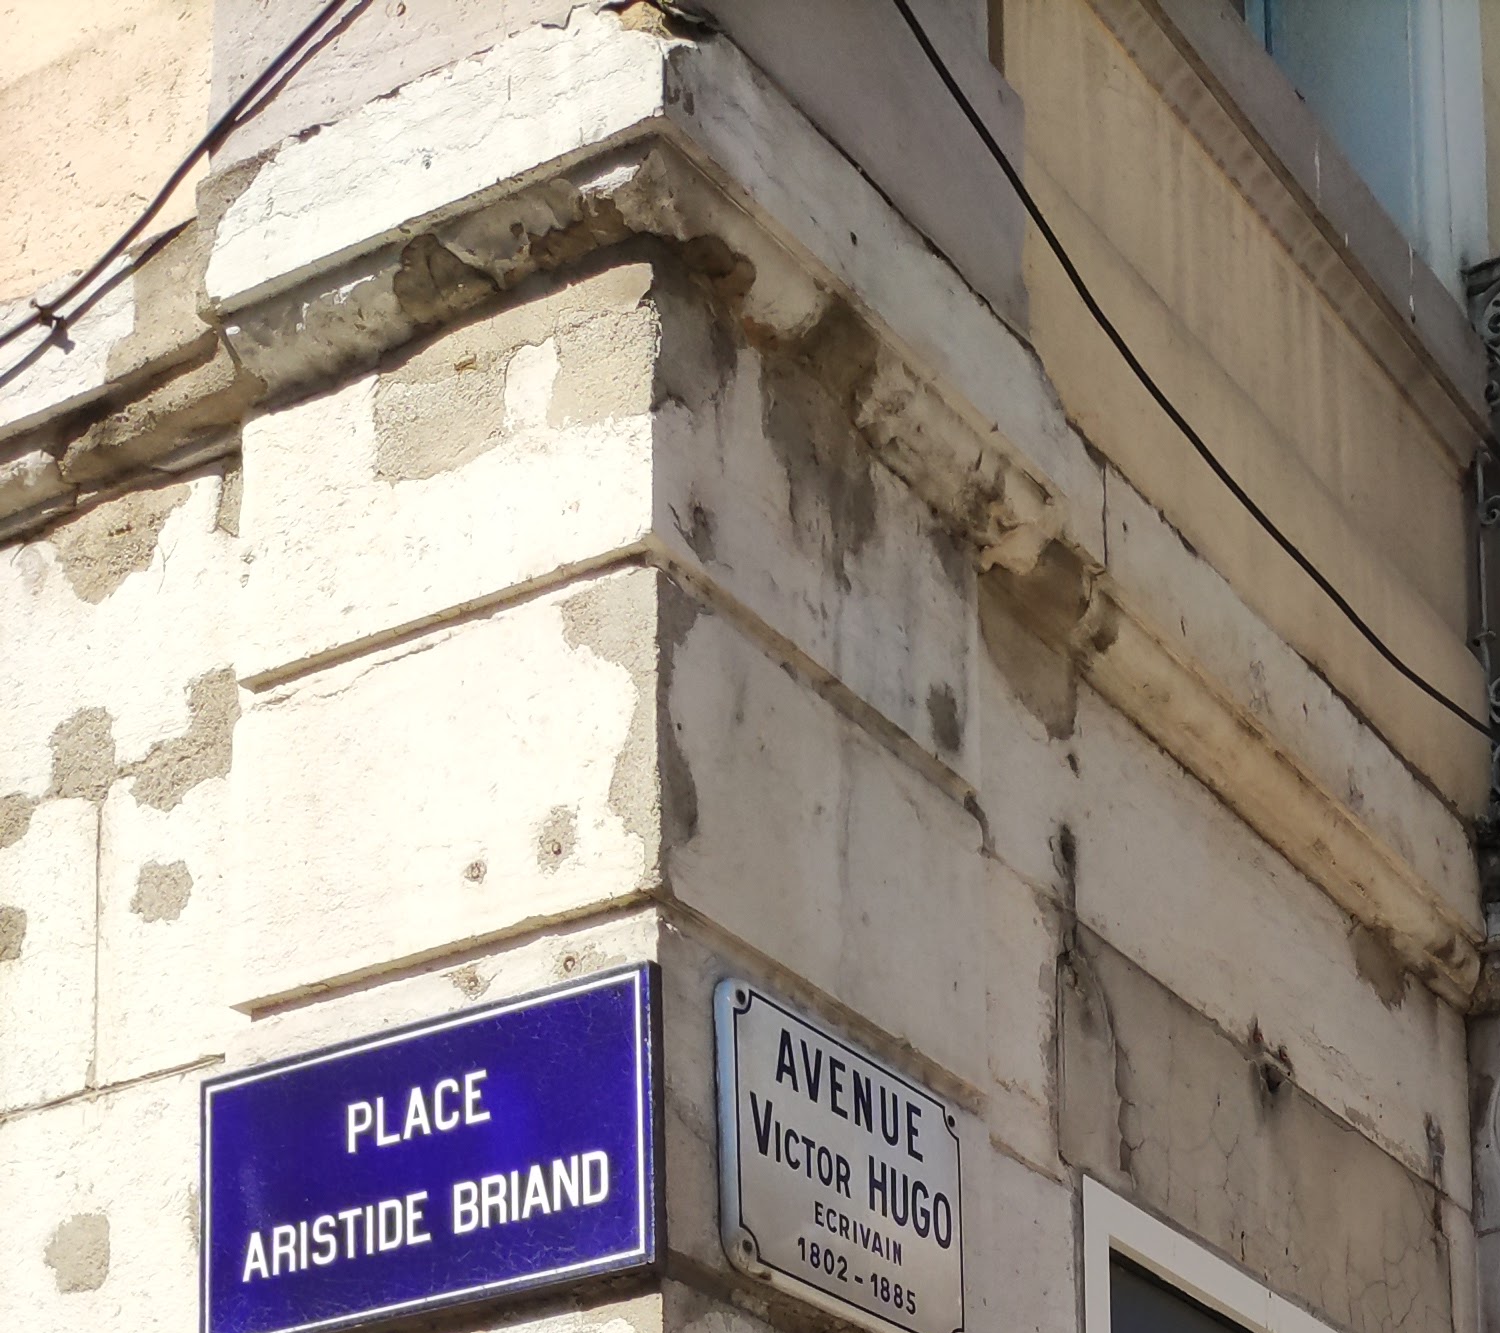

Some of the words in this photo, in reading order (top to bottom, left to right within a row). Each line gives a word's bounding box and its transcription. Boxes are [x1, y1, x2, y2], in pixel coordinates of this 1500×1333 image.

[347, 1068, 491, 1153] PLACE
[775, 1028, 924, 1163] AVENUE
[243, 1190, 431, 1283] ARISTIDE
[453, 1150, 609, 1234] BRIAND
[814, 1200, 902, 1267] ECRIVAIN
[868, 1155, 951, 1250] HUGO
